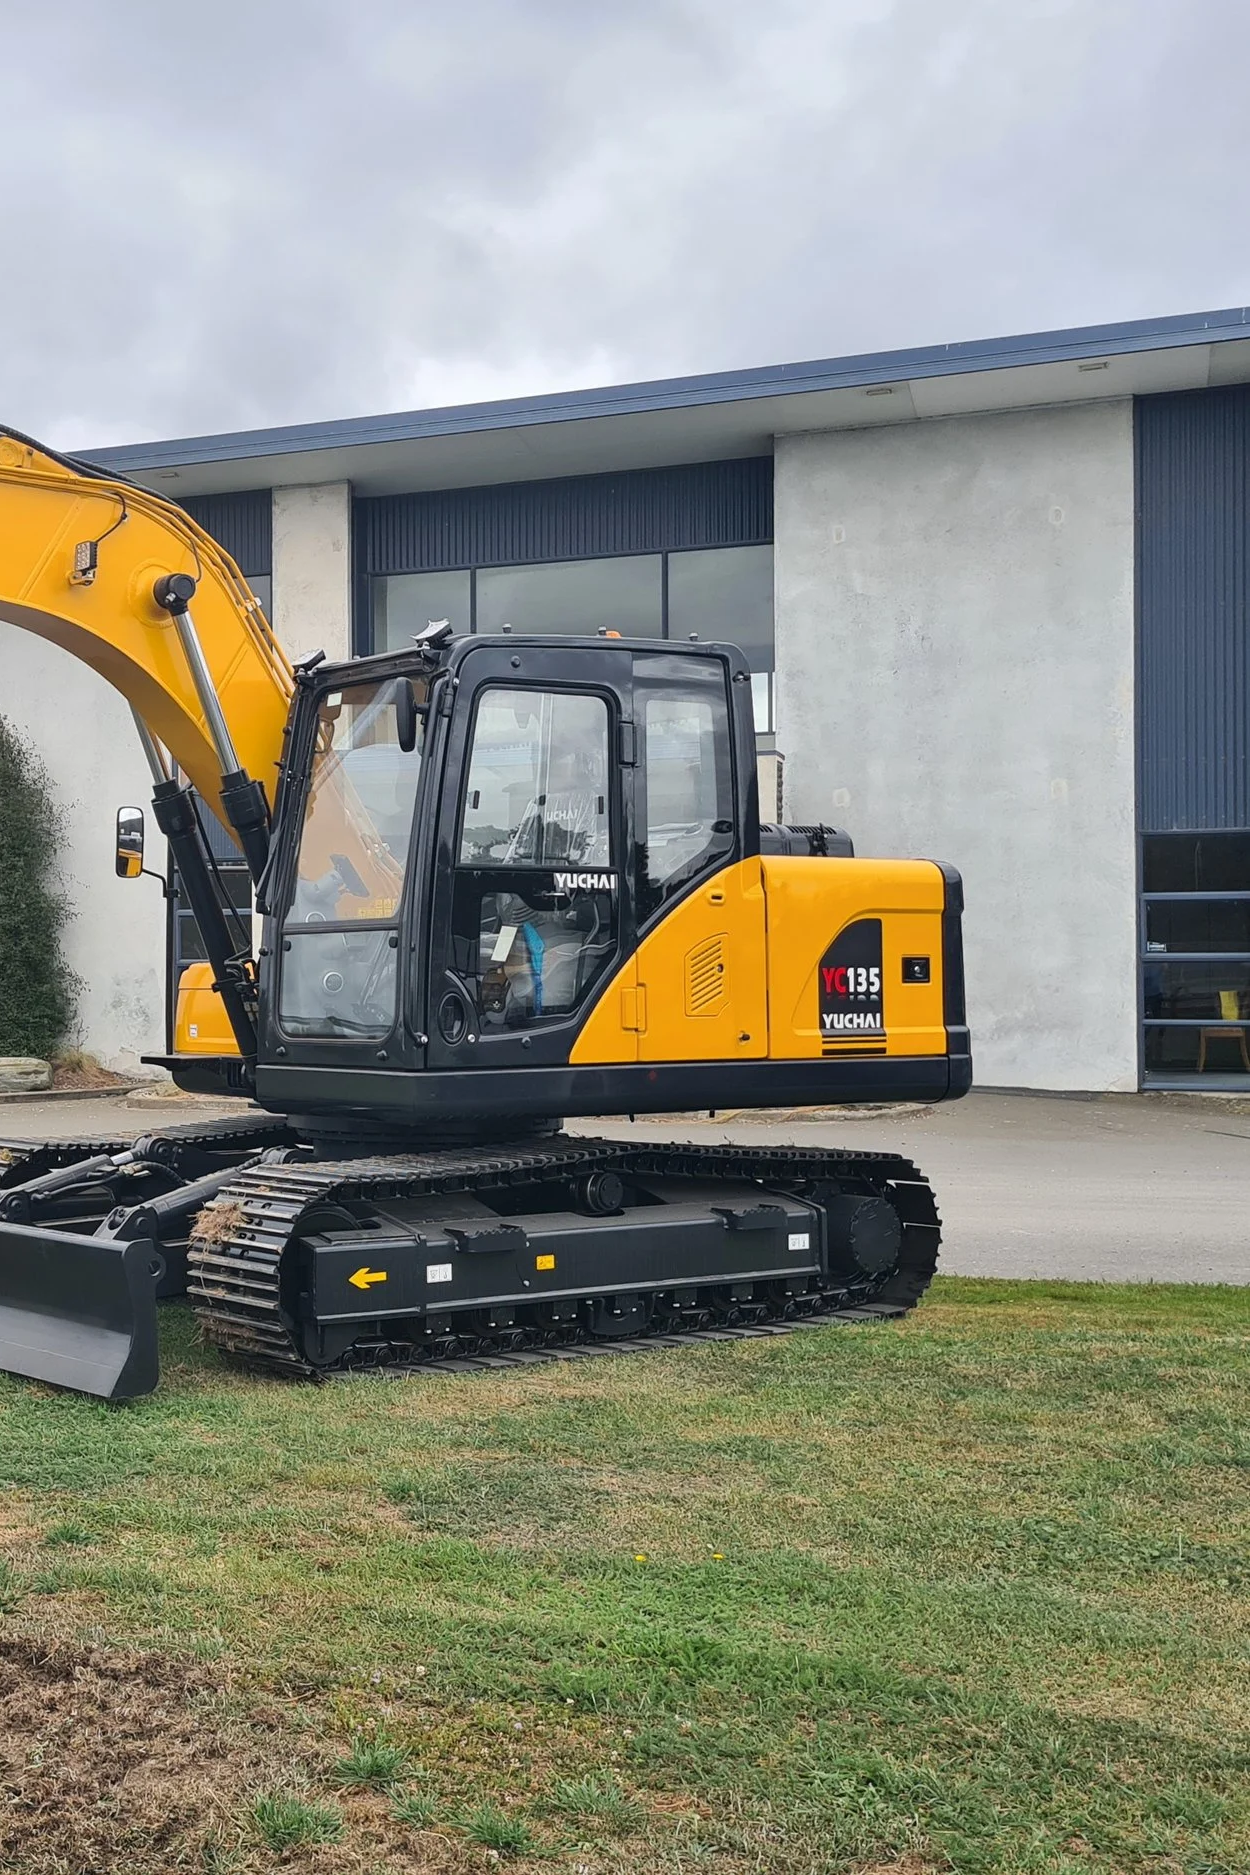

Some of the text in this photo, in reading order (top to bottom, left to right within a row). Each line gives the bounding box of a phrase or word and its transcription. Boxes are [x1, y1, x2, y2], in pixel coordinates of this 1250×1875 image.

[555, 873, 615, 889] YUCHAI
[822, 967, 880, 993] YC135
[822, 1013, 881, 1029] YUCHAI
